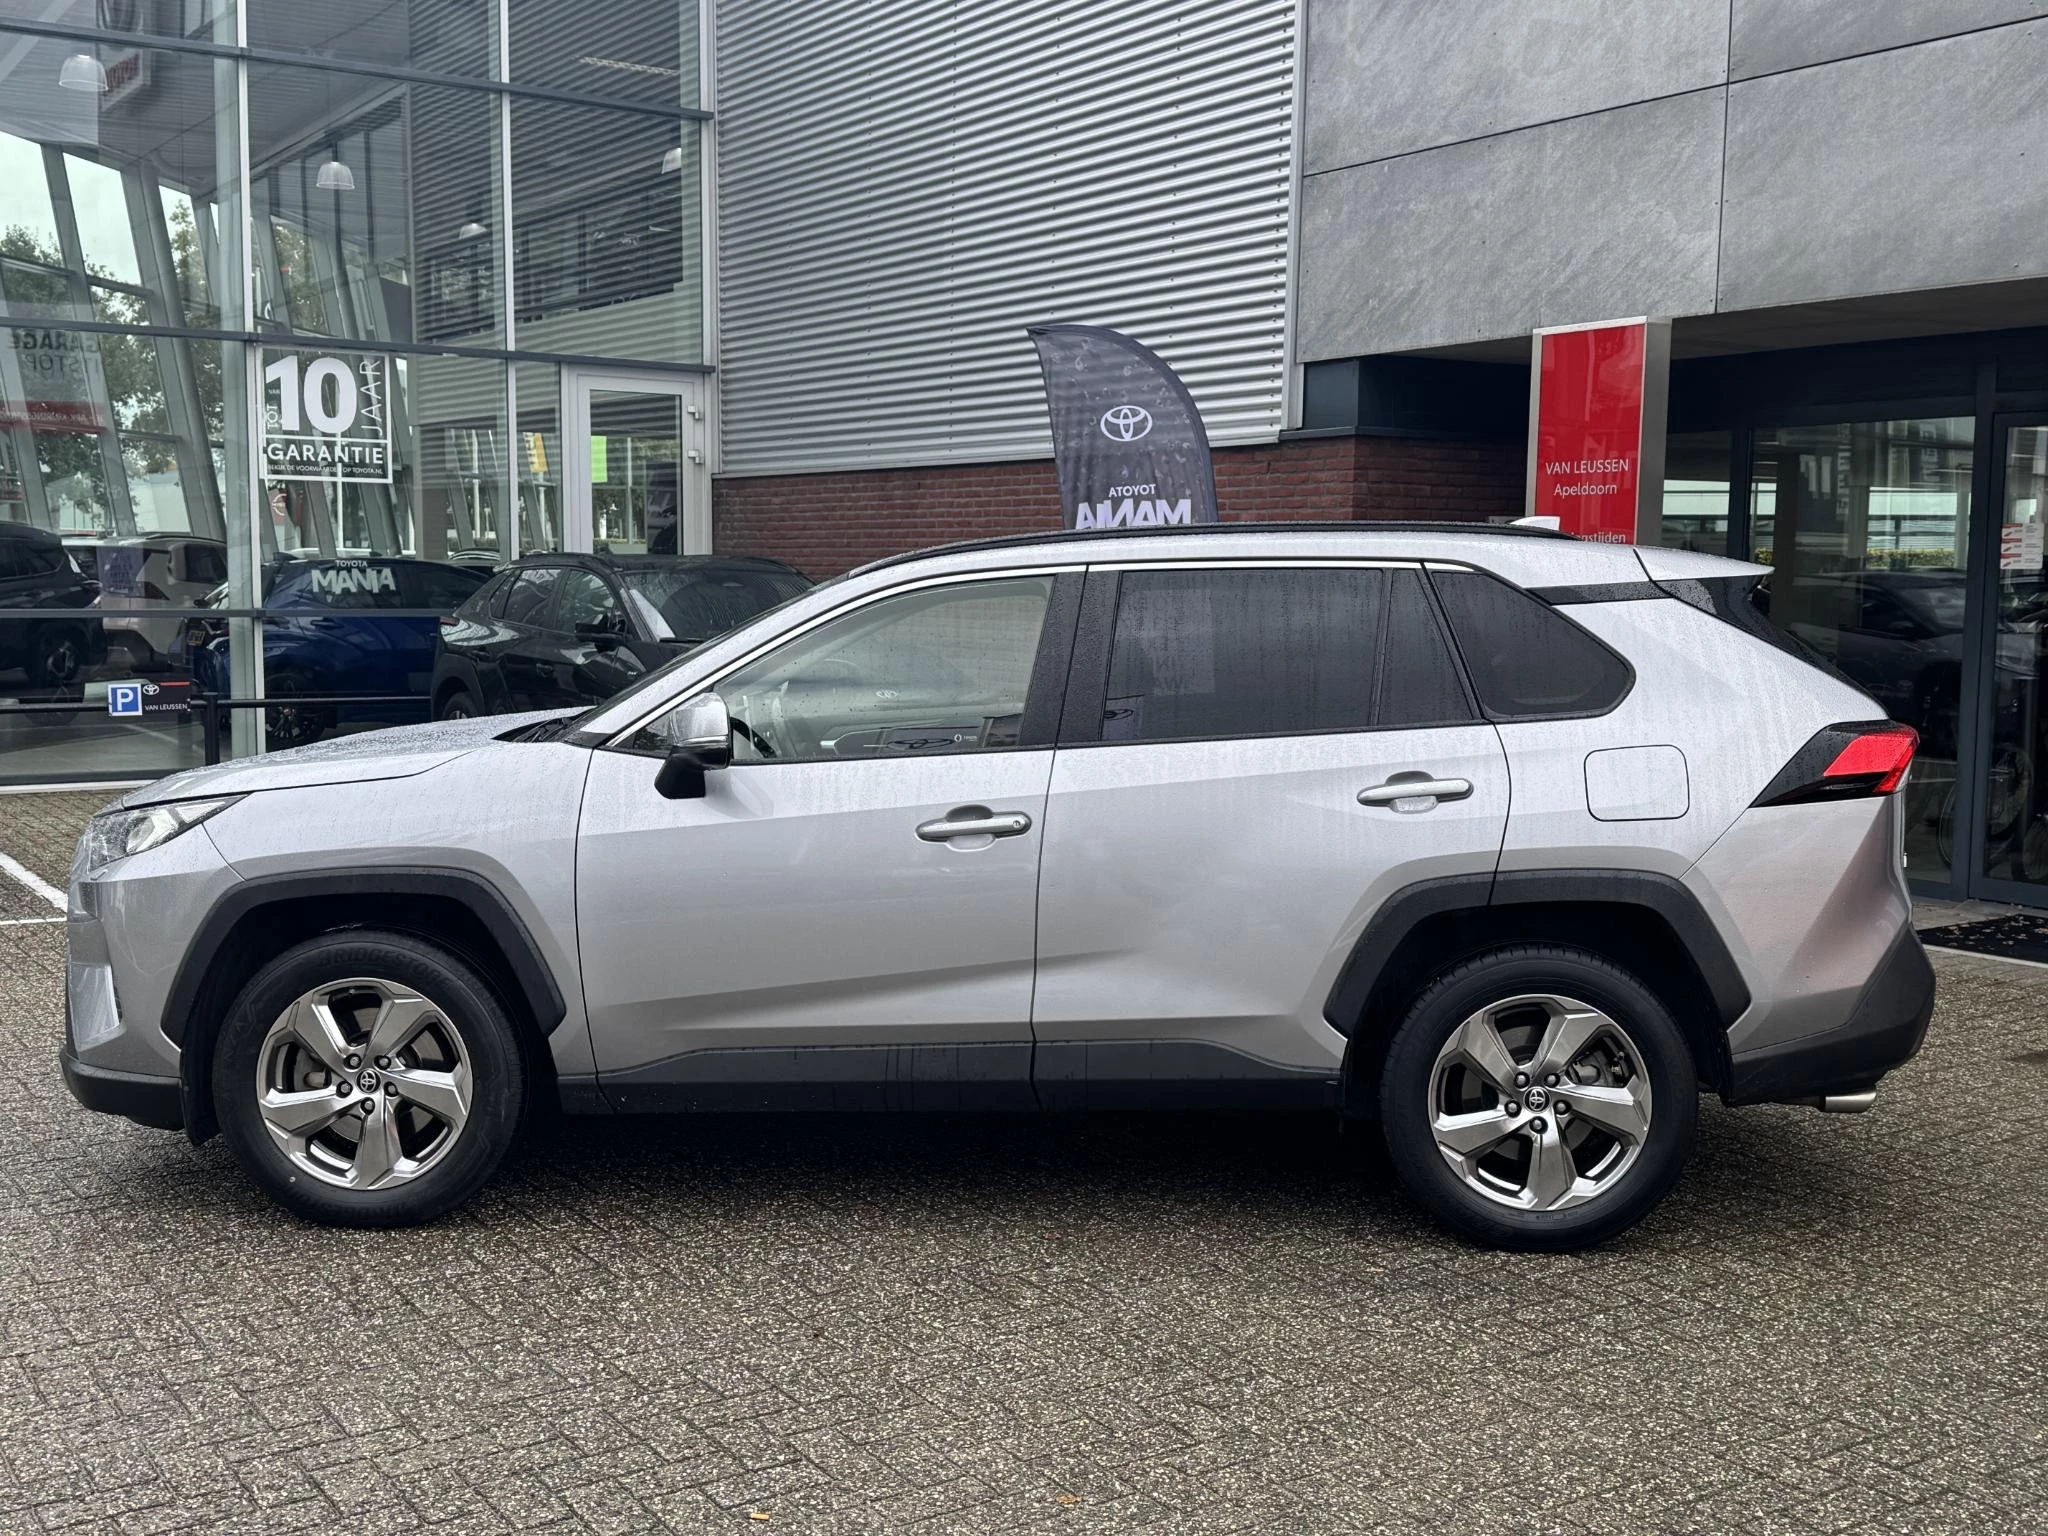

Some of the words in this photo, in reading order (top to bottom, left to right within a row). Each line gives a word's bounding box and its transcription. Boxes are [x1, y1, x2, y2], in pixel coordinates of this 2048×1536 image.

[265, 355, 358, 434] 10
[360, 360, 383, 437] JAAR
[266, 402, 280, 430] TOT
[267, 443, 384, 465] GARANTIE
[1545, 461, 1570, 475] VAN
[1574, 459, 1629, 474] LEUSSEN
[1554, 482, 1617, 499] Apeldoorn
[335, 560, 368, 568] TOYOTA
[311, 567, 397, 595] MANIA
[116, 688, 134, 712] P
[160, 703, 188, 711] LEUSSEN
